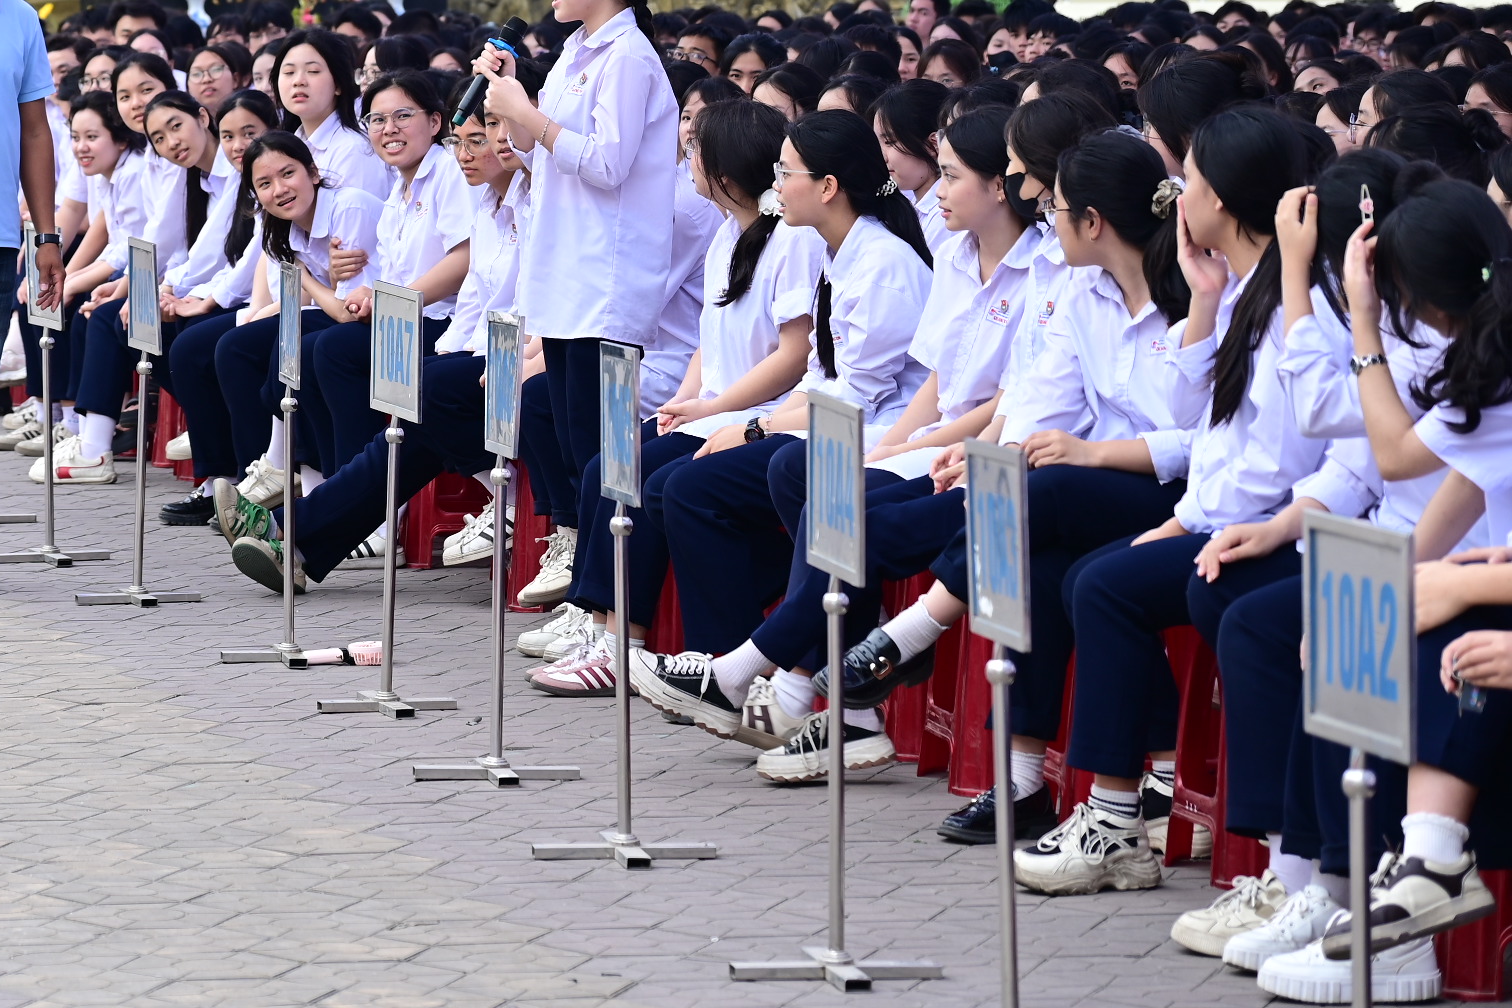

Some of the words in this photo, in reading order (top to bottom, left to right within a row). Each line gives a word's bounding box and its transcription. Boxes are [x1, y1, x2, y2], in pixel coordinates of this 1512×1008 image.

[379, 314, 414, 387] 10A7
[817, 434, 855, 538] 10A4
[1322, 570, 1400, 704] 10A2
